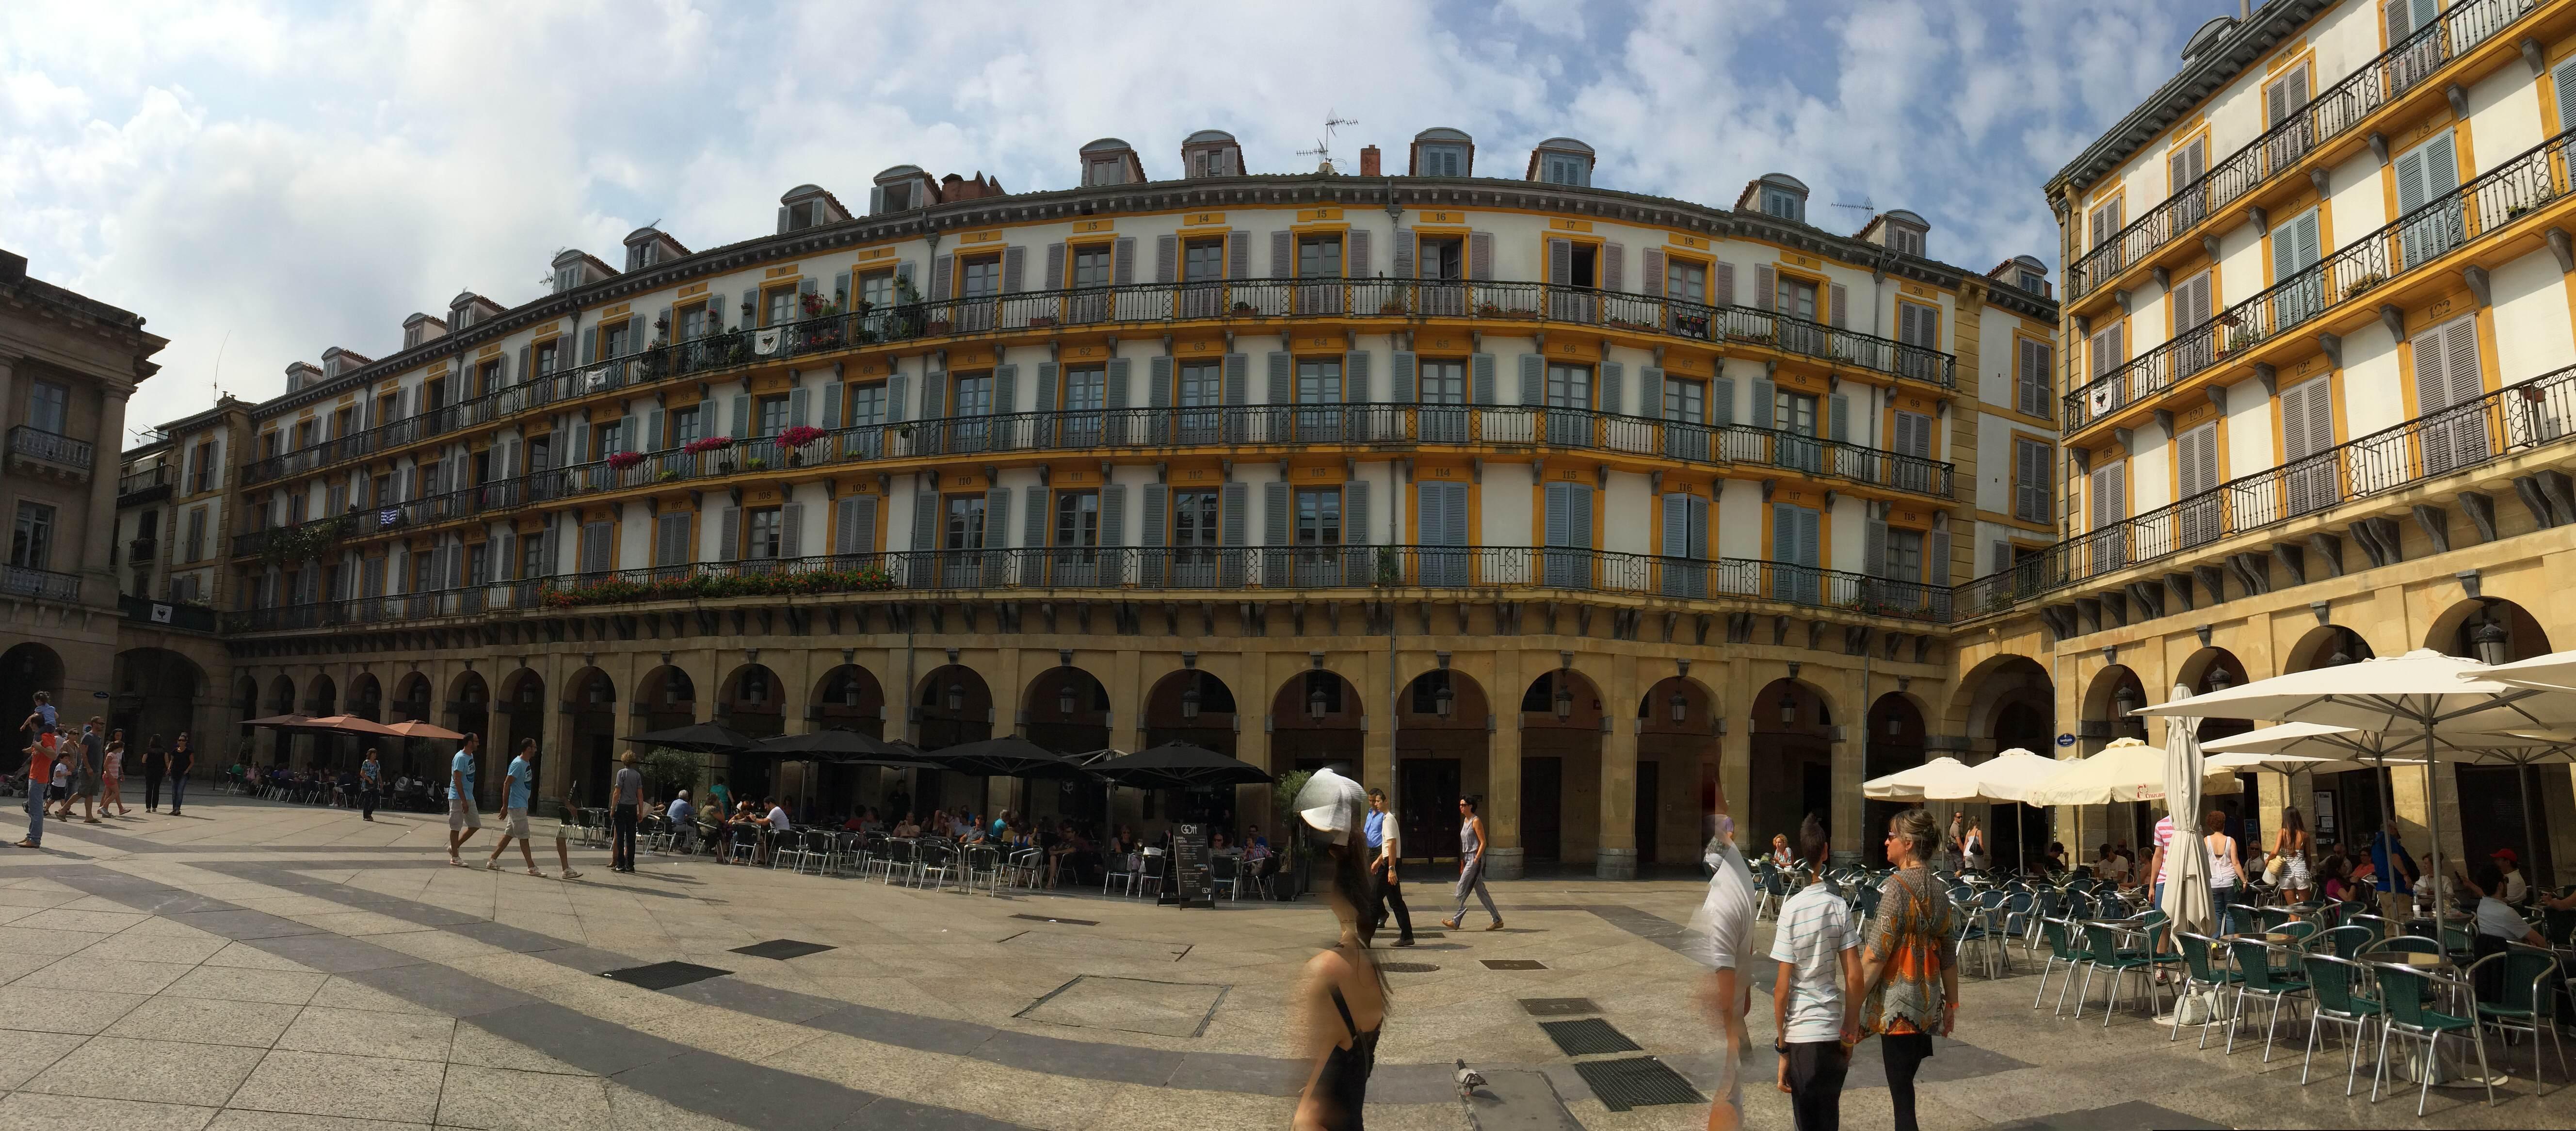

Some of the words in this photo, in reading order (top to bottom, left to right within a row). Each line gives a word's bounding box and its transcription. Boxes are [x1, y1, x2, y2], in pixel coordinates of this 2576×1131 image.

[2281, 48, 2292, 62] 23
[2183, 122, 2192, 132] 22
[2415, 124, 2430, 138] 73
[2289, 199, 2301, 213] 72
[1199, 214, 1209, 222] 14
[1317, 210, 1327, 218] 15
[1088, 222, 1097, 230] 13
[1566, 221, 1576, 229] 17
[1685, 237, 1694, 245] 18
[873, 249, 880, 257] 11
[1797, 257, 1805, 265] 19
[1914, 287, 1923, 295] 20
[2429, 300, 2450, 319] 122
[2104, 311, 2112, 322] 70
[1194, 341, 1206, 350] 63
[1314, 338, 1327, 347] 64
[1436, 339, 1449, 348] 65
[1080, 347, 1091, 355] 62
[1564, 345, 1576, 353] 66
[967, 355, 977, 364] 61
[1682, 360, 1694, 369] 67
[2296, 360, 2310, 376] 121
[769, 380, 778, 388] 59
[1795, 375, 1806, 384] 68
[681, 393, 689, 401] 58
[1910, 399, 1920, 407] 69
[2189, 407, 2203, 421] 120
[2103, 448, 2112, 459] 119
[1071, 473, 1082, 481] 111
[1189, 470, 1203, 479] 112
[1312, 468, 1326, 477] 113
[1435, 468, 1450, 477] 114
[1563, 470, 1577, 479] 115
[959, 477, 971, 485] 110
[1679, 483, 1692, 492] 116
[758, 491, 771, 500] 108
[1789, 491, 1801, 500] 117
[1904, 512, 1916, 521] 118
